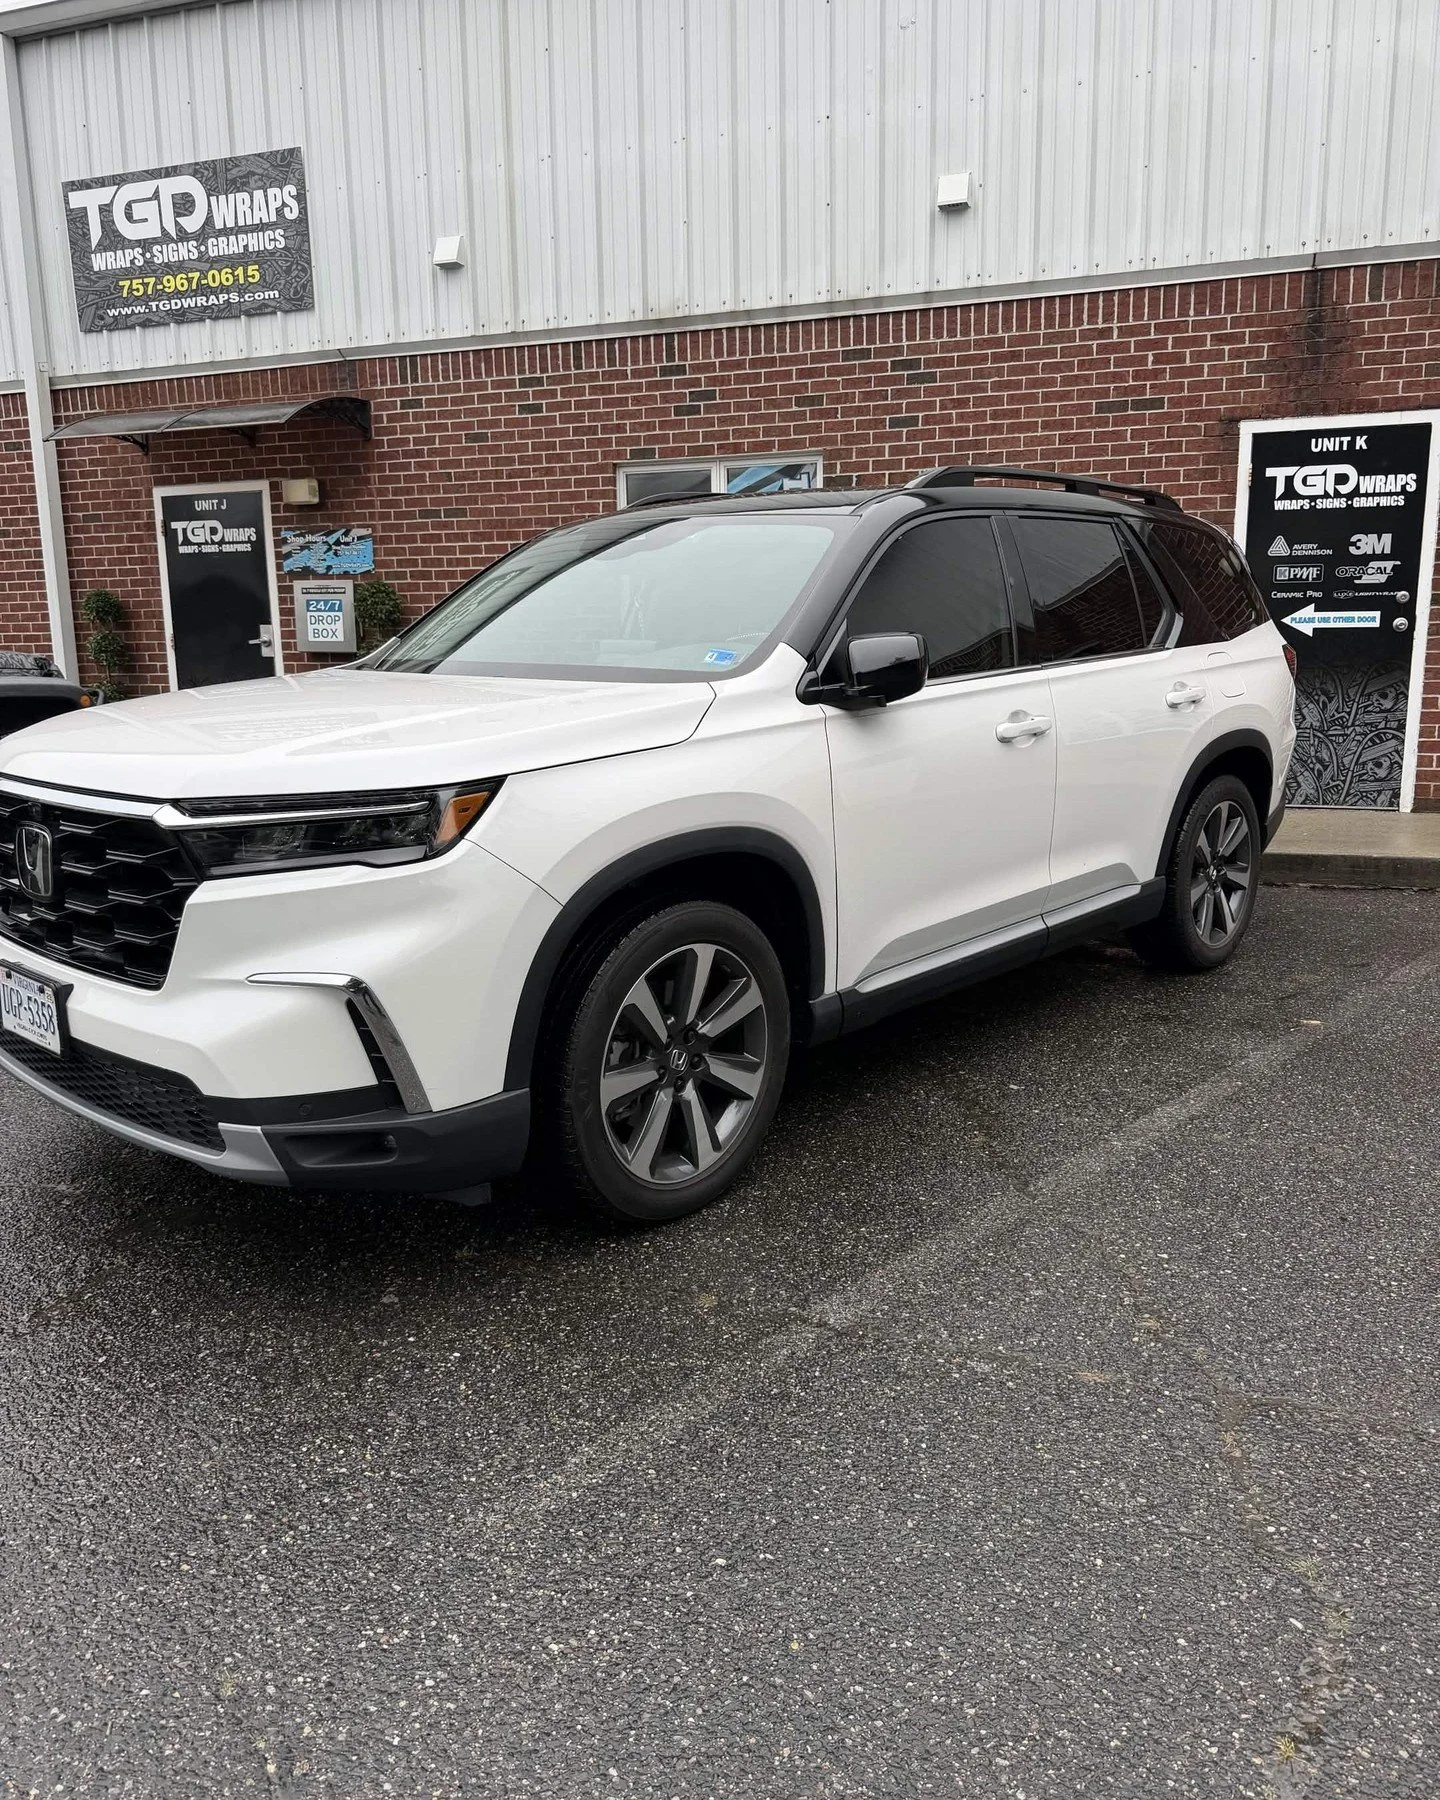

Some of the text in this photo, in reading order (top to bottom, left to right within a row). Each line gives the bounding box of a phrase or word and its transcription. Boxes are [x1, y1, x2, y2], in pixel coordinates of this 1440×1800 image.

[67, 174, 300, 252] TGD WRAPS
[91, 229, 286, 272] WRAPS SIGNS GRAPHICS
[118, 264, 261, 298] 757-967-0615
[106, 289, 280, 317] www.TGDWRAPS.com
[1310, 435, 1368, 452] UNIT K
[1265, 464, 1417, 499] TGD WRAPS
[194, 499, 227, 512] UNIT J
[1274, 495, 1405, 511] WRAPS SIGNS GRAPHICS
[171, 520, 257, 545] TGD WRAPS
[286, 534, 327, 544] Shop Hours
[339, 535, 353, 543] Unit
[178, 543, 252, 554] WRAPS SIGNS GRAPHICS
[1348, 533, 1392, 555] 3M
[1335, 566, 1393, 577] ORACAL
[308, 600, 340, 611] 24/7
[309, 614, 341, 626] DROP
[1290, 616, 1316, 624] PLEASE
[1357, 615, 1377, 623] DOOR
[312, 628, 339, 639] BOX
